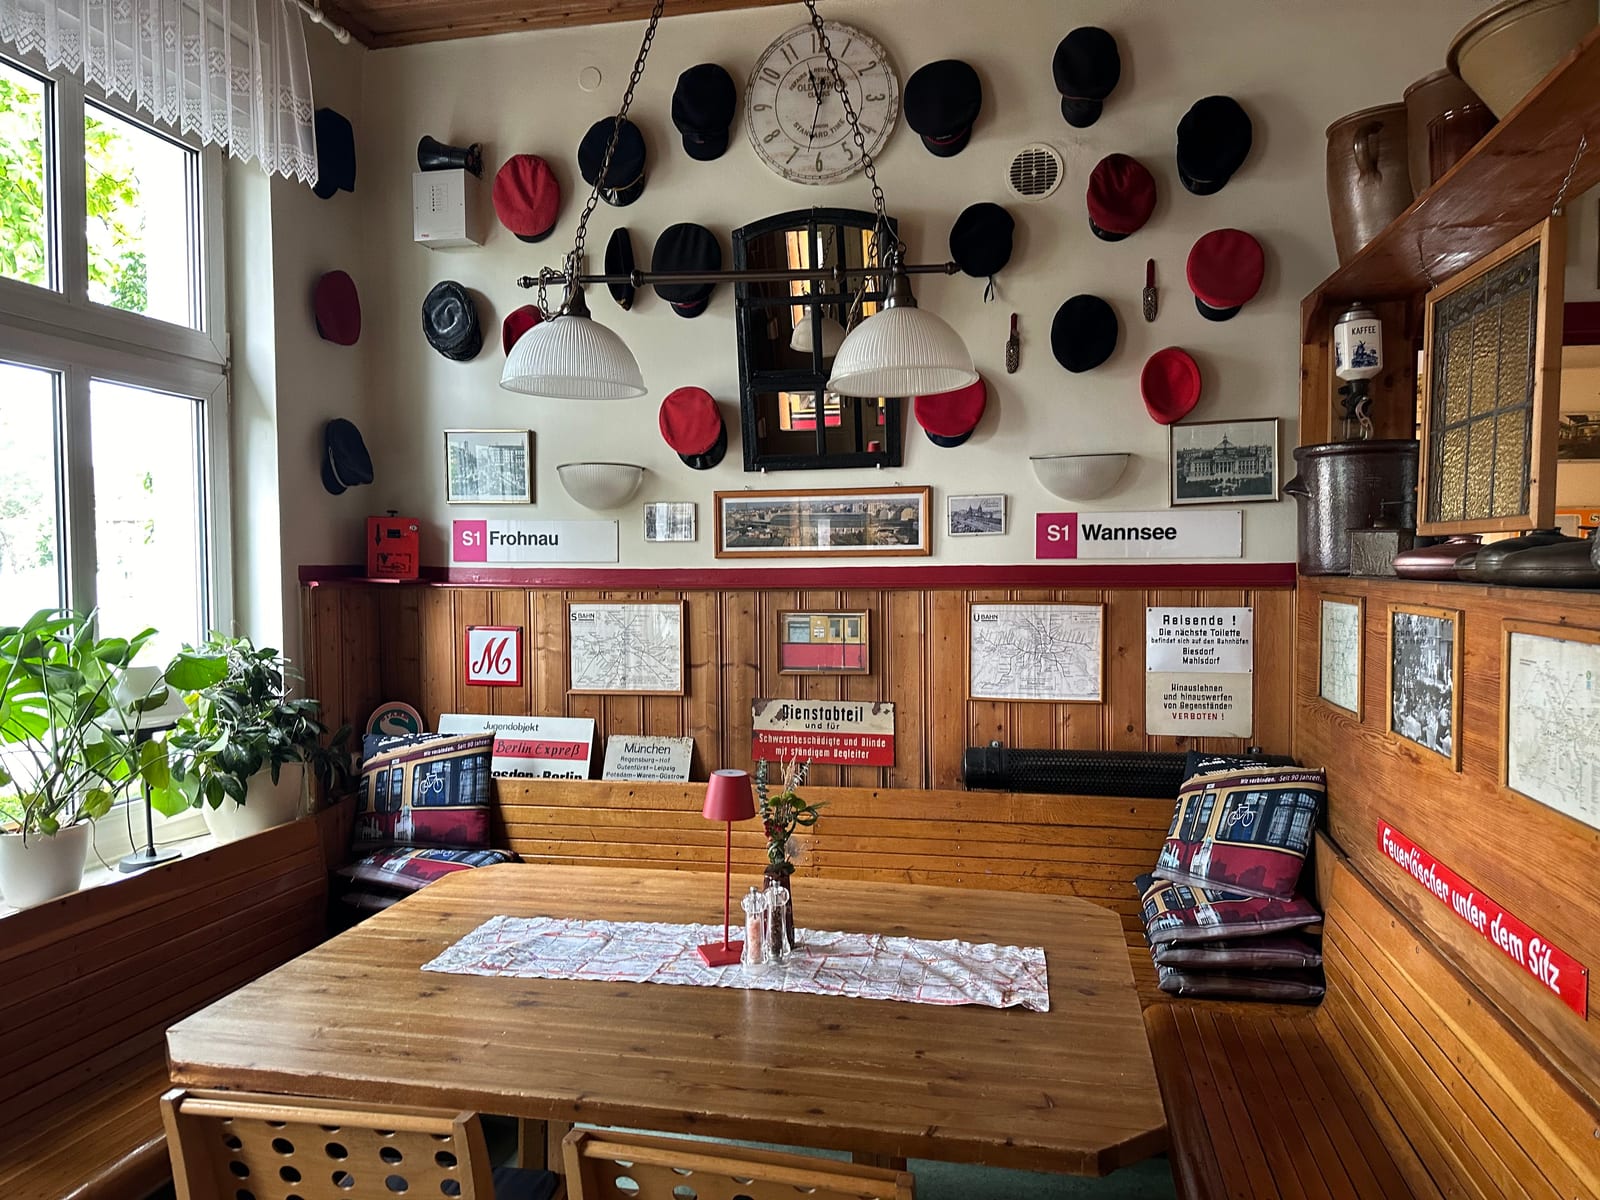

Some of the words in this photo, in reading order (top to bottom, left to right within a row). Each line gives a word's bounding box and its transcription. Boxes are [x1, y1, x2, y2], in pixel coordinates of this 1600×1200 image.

[780, 43, 799, 65] 11
[841, 38, 852, 58] 1
[857, 60, 877, 76] 2
[758, 67, 781, 86] 10
[865, 93, 886, 102] 3
[752, 103, 773, 112] 9
[859, 122, 877, 135] 4
[763, 128, 781, 144] 8
[786, 146, 800, 164] 7
[841, 141, 854, 161] 5
[815, 151, 823, 172] 6
[1351, 325, 1376, 335] KAFFEE
[462, 531, 481, 546] S1
[489, 531, 559, 546] Frohnau
[1047, 524, 1069, 541] S1
[1082, 524, 1177, 540] Wannsee
[1163, 615, 1224, 626] Reisende
[1159, 628, 1171, 636] Die
[1175, 628, 1207, 637] nächste
[1210, 628, 1241, 637] Toilette
[472, 637, 512, 675] M
[1182, 647, 1214, 656] Biesdorf
[1171, 683, 1223, 692] Hinauslehnen
[1180, 693, 1233, 702] hinauswerfen
[782, 703, 863, 722] Dienstabteil
[1180, 701, 1233, 711] Gegenständen
[1172, 712, 1218, 720] VERBOTEN
[483, 721, 539, 733] Jugendobjekt
[805, 722, 822, 730] und
[826, 722, 840, 730] für
[759, 733, 840, 747] Schwerstbeschädigte
[844, 737, 858, 746] und
[861, 737, 886, 748] Blinde
[496, 740, 532, 754] Berlin
[535, 743, 580, 757] Expreß
[624, 742, 671, 754] München
[775, 747, 787, 756] mit
[791, 748, 830, 758] ständigem
[833, 749, 869, 759] Begleiter
[1382, 827, 1449, 904] Feuerlöscher
[1452, 889, 1487, 933] unter
[1490, 913, 1525, 966] dem
[1528, 937, 1561, 995] Sitz
